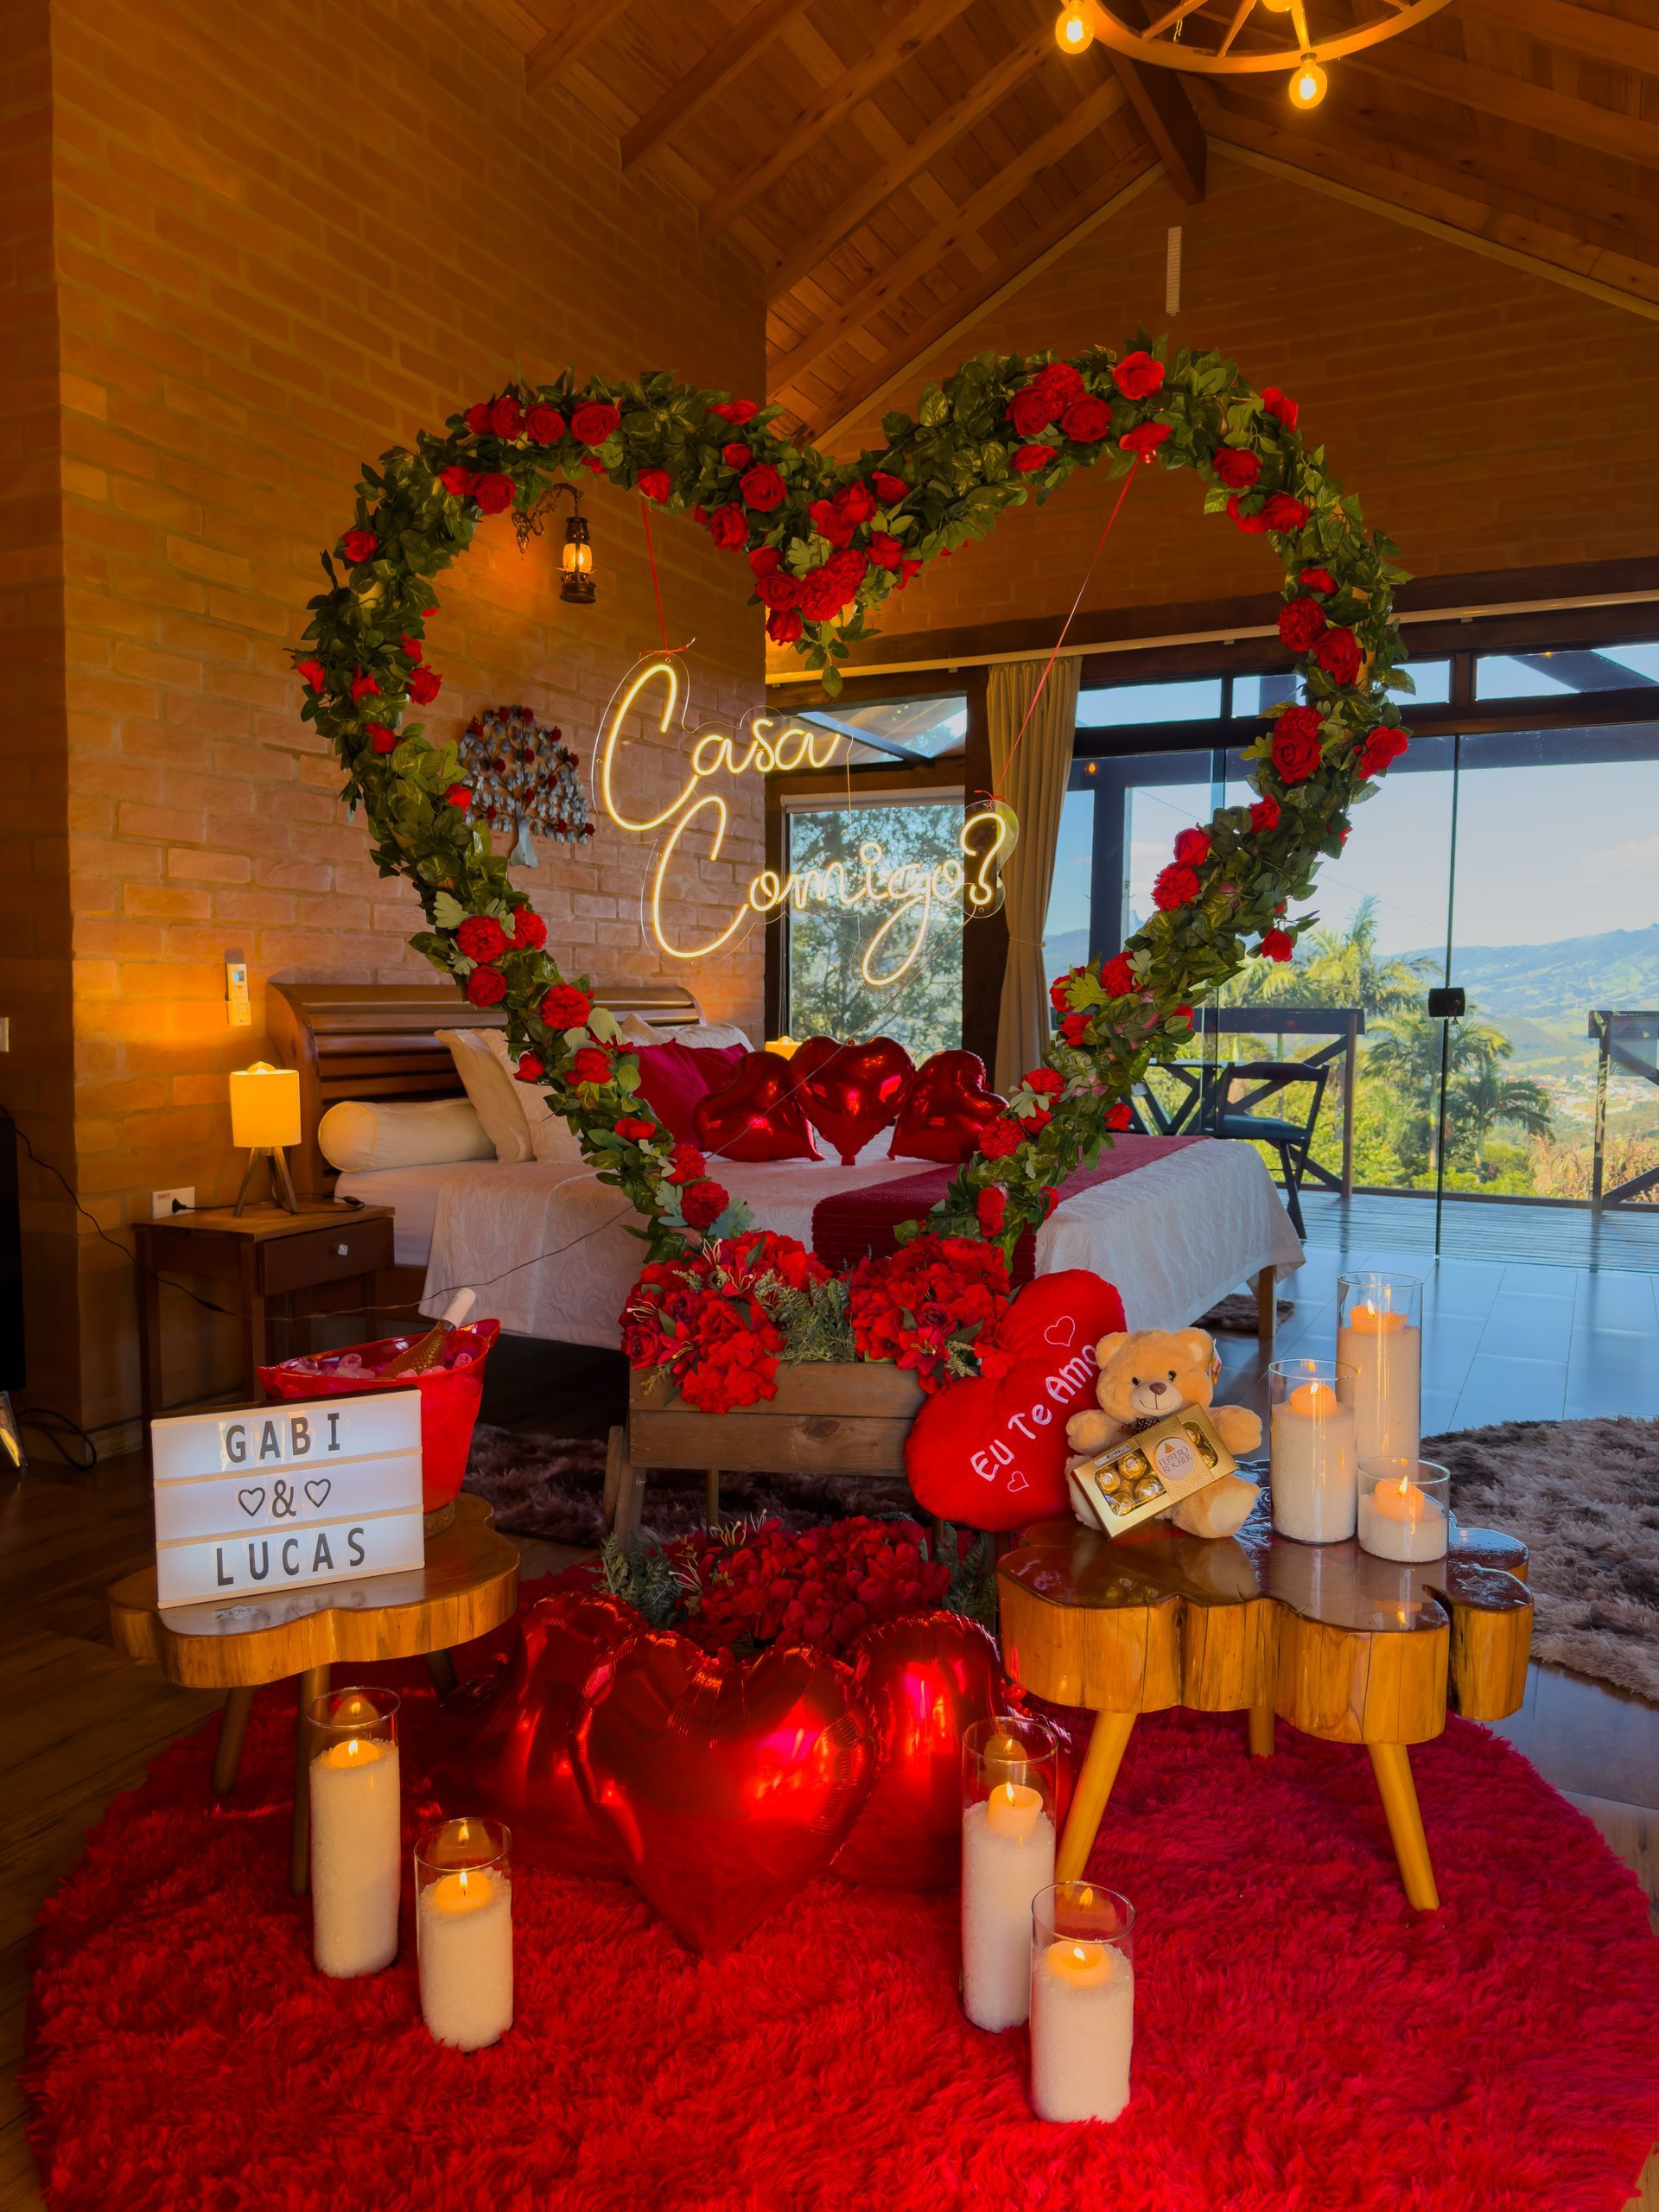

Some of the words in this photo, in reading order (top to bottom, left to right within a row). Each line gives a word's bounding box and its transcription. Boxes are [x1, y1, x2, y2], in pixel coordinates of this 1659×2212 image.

[604, 664, 840, 831] Casa
[653, 795, 1007, 986] Comigo?
[226, 1413, 340, 1463] GABI
[1007, 1404, 1052, 1440] Te
[1158, 1446, 1189, 1466] FERRERO
[1163, 1453, 1193, 1473] ROCHER
[271, 1479, 296, 1518] &
[216, 1527, 365, 1586] LUCAS
